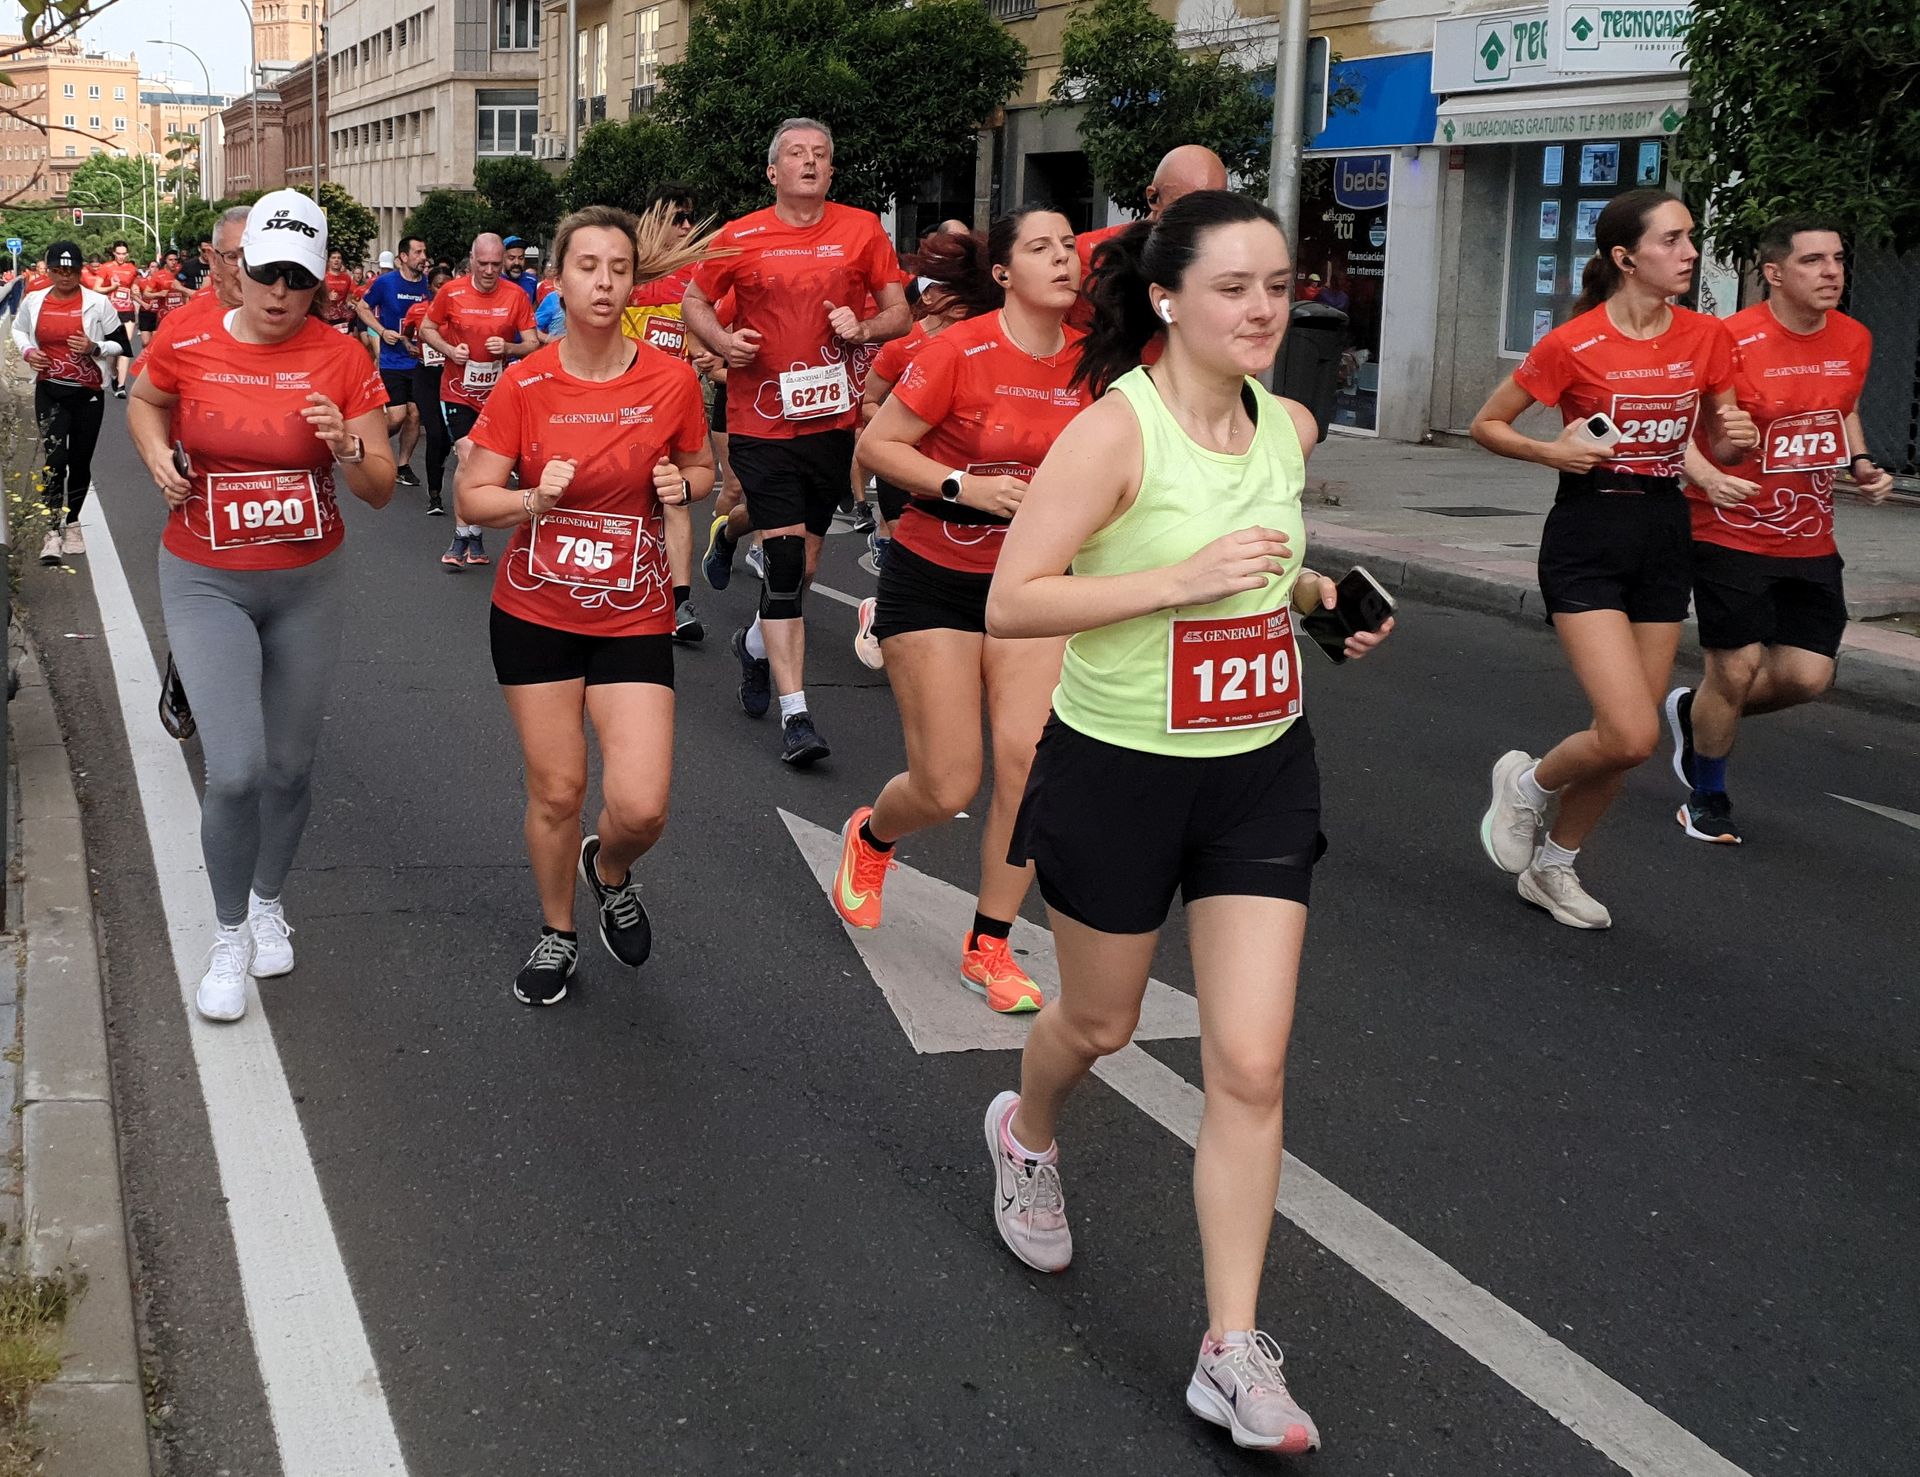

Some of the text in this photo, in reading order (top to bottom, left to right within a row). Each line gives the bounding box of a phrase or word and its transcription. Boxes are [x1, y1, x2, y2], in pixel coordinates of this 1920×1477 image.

[1463, 120, 1525, 137] VALORACIONES
[1526, 115, 1575, 134] GRATUITAS
[1599, 113, 1615, 131] 910
[1635, 111, 1654, 128] 017
[274, 210, 290, 218] KB
[262, 218, 319, 239] STARS
[1348, 250, 1384, 261] financiación
[650, 329, 683, 349] 2059
[469, 371, 499, 383] 5487
[1619, 368, 1665, 379] GENERALI
[1777, 364, 1821, 376] GENERALI
[217, 372, 293, 386] GENERALI 10K
[791, 382, 841, 408] 6278
[1008, 386, 1050, 400] GENERALI
[1632, 401, 1673, 411] GENERALI
[564, 407, 637, 424] GENERALI 10K
[620, 416, 653, 425] INCLUSION
[1619, 416, 1689, 444] 2396
[1773, 431, 1838, 458] 2473
[987, 467, 1031, 476] GENERALI
[228, 476, 292, 491] GENERALI 10K
[223, 498, 304, 530] 1920
[556, 516, 619, 530] GENERALI 10K
[556, 535, 614, 570] 795
[1203, 616, 1281, 642] GENERALI 10K
[1193, 649, 1290, 703] 1219
